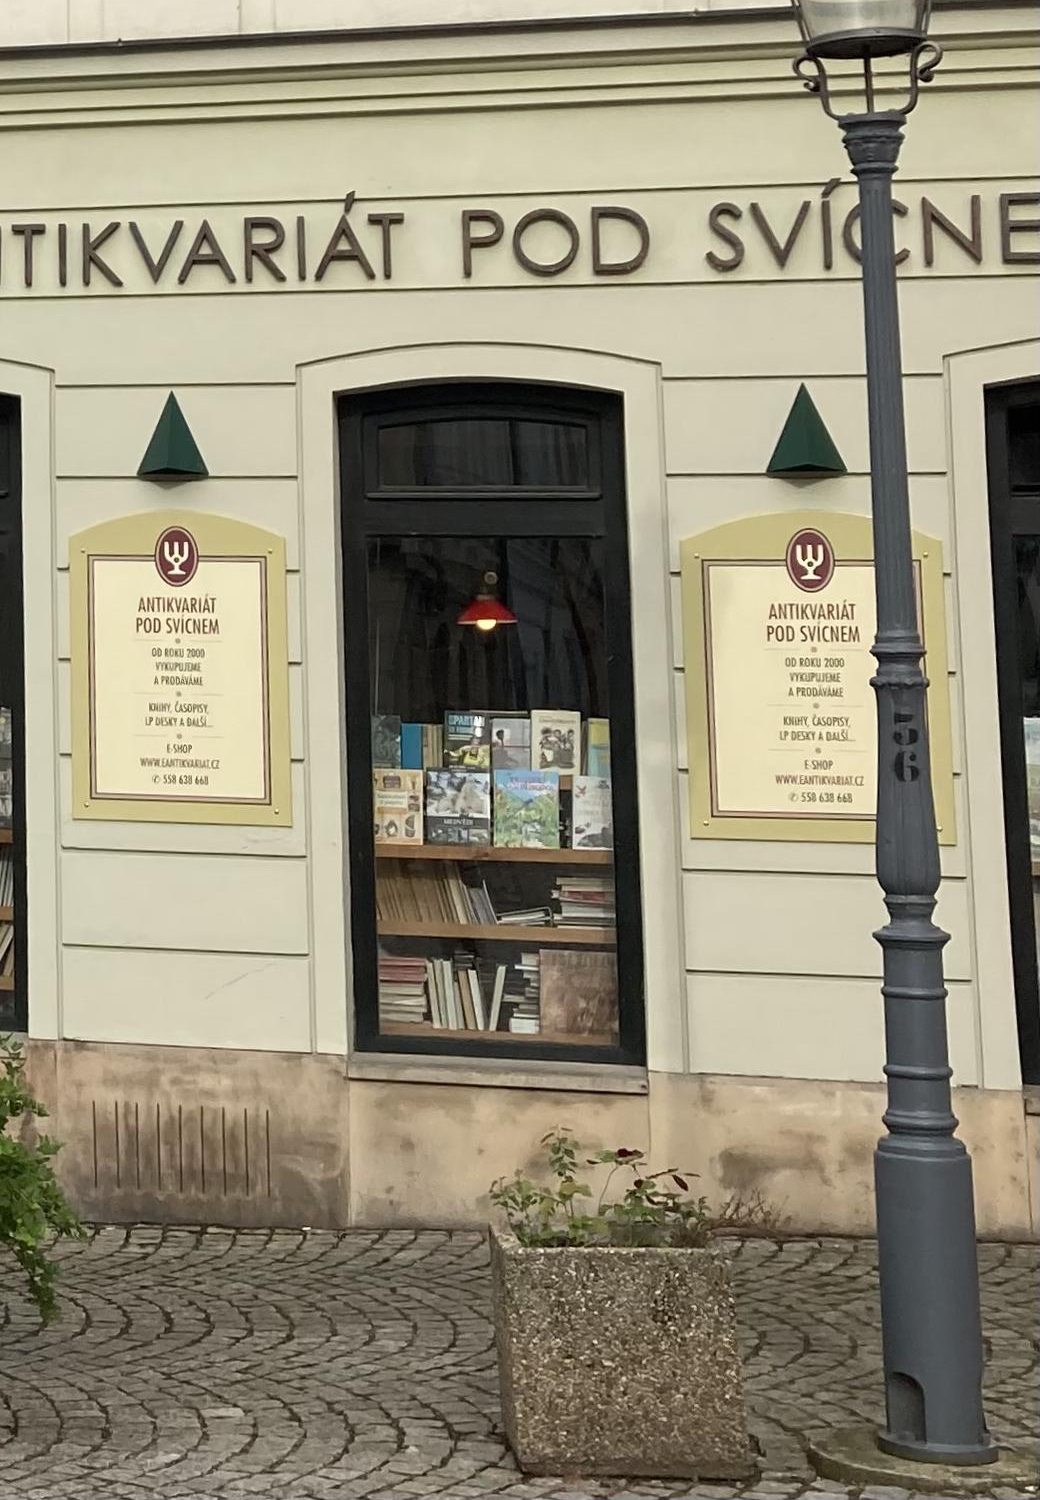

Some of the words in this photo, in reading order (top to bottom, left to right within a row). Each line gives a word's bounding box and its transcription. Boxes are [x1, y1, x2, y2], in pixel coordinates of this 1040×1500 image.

[461, 206, 650, 279] POD
[138, 593, 217, 614] ANTIKVARIÁT
[768, 599, 856, 621] ANTIKVARIÁT
[136, 618, 161, 634] POD
[166, 614, 220, 635] SVÍCNEM
[767, 626, 795, 642] POD
[800, 621, 860, 643] SVÍCNEM
[151, 648, 162, 658] OD
[164, 648, 185, 658] ROKU
[186, 648, 205, 658] 2000
[155, 662, 201, 672] VYKUPUJEME
[785, 657, 797, 668] OD
[799, 657, 822, 668] ROKU
[824, 657, 845, 668] 2000
[153, 676, 160, 685] A
[161, 674, 203, 686] PRODÁVÁME
[789, 672, 841, 683] VYKUPUJEME
[788, 687, 795, 697] A
[796, 685, 843, 698] PRODÁVÁME
[148, 703, 172, 714] KNIHY,
[145, 717, 154, 727] LP
[155, 717, 177, 727] DESKY
[179, 718, 185, 727] A
[783, 716, 810, 727] KNIHY,
[780, 730, 789, 740] LP
[791, 730, 817, 741] DESKY
[818, 731, 824, 741] A
[166, 744, 193, 754] E-SHOP
[163, 775, 177, 785] 558
[775, 775, 865, 787] WWW.EANTIKVARIAT.CZ
[801, 792, 817, 803] 558
[819, 792, 835, 803] 638
[837, 792, 853, 803] 668
